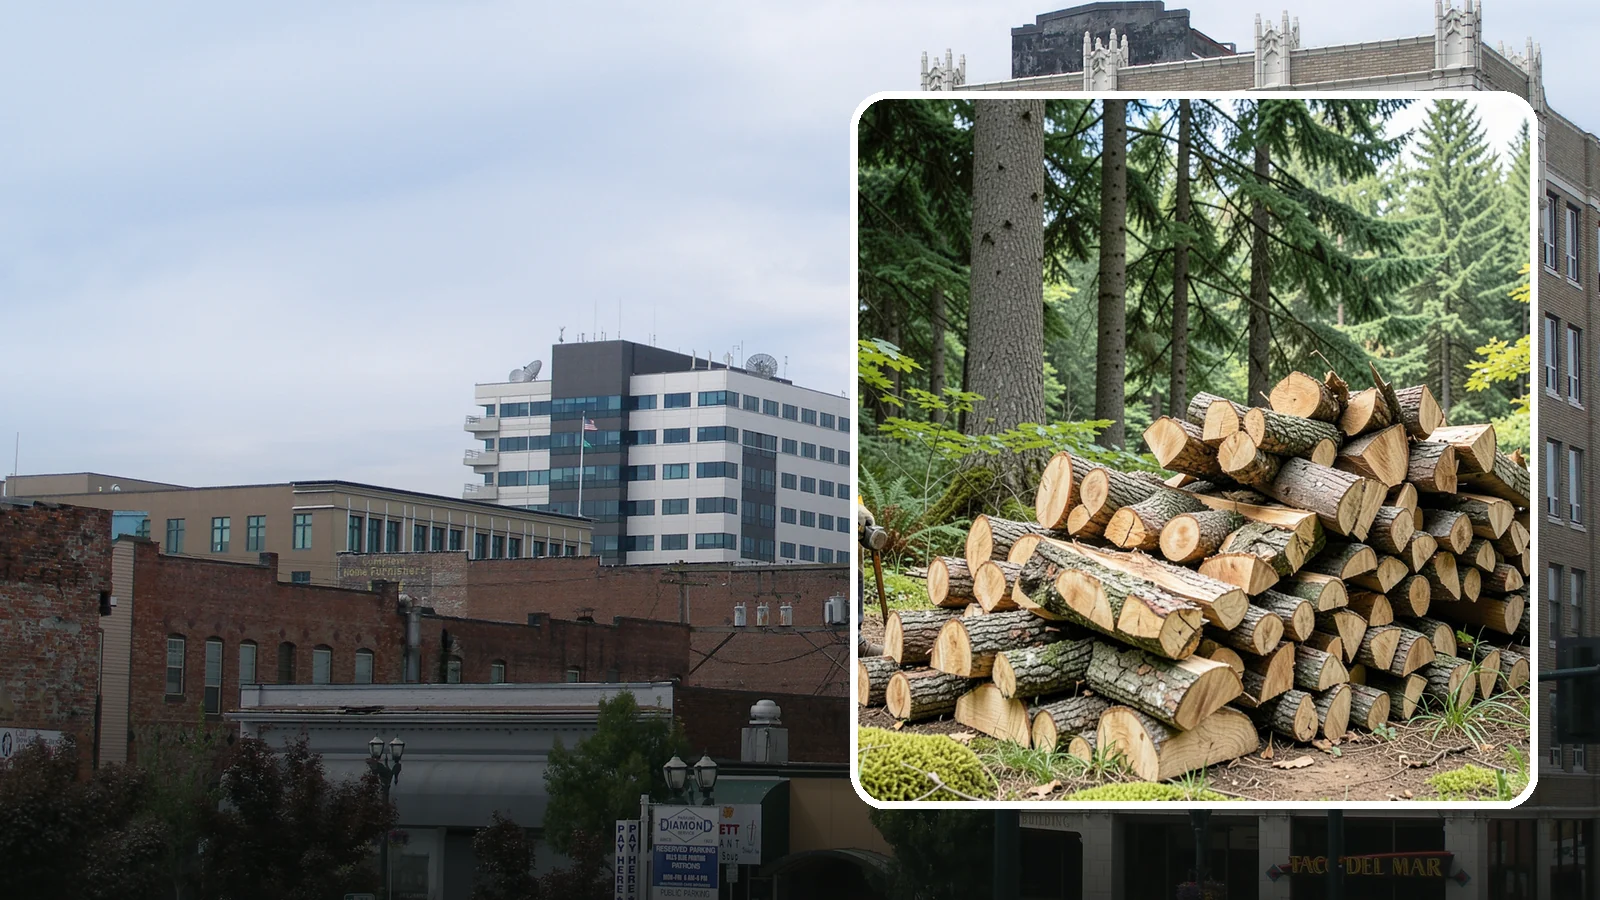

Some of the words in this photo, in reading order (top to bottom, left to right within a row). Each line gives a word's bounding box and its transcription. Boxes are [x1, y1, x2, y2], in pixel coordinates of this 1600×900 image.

[370, 566, 427, 577] Furnishers
[660, 818, 713, 833] DIAMOND
[1022, 815, 1070, 828] BUILDING
[617, 824, 625, 853] PAY
[628, 824, 637, 853] PAY
[655, 845, 688, 853] RESERVED
[689, 846, 716, 854] PARKING
[671, 862, 701, 870] PATRONS
[1289, 855, 1330, 874] TAC
[1346, 856, 1385, 875] DEL
[1392, 857, 1443, 876] MAR
[616, 856, 625, 894] HERE
[627, 856, 636, 894] HERE
[660, 888, 682, 897] PUBLIC
[683, 889, 710, 898] PARKING
